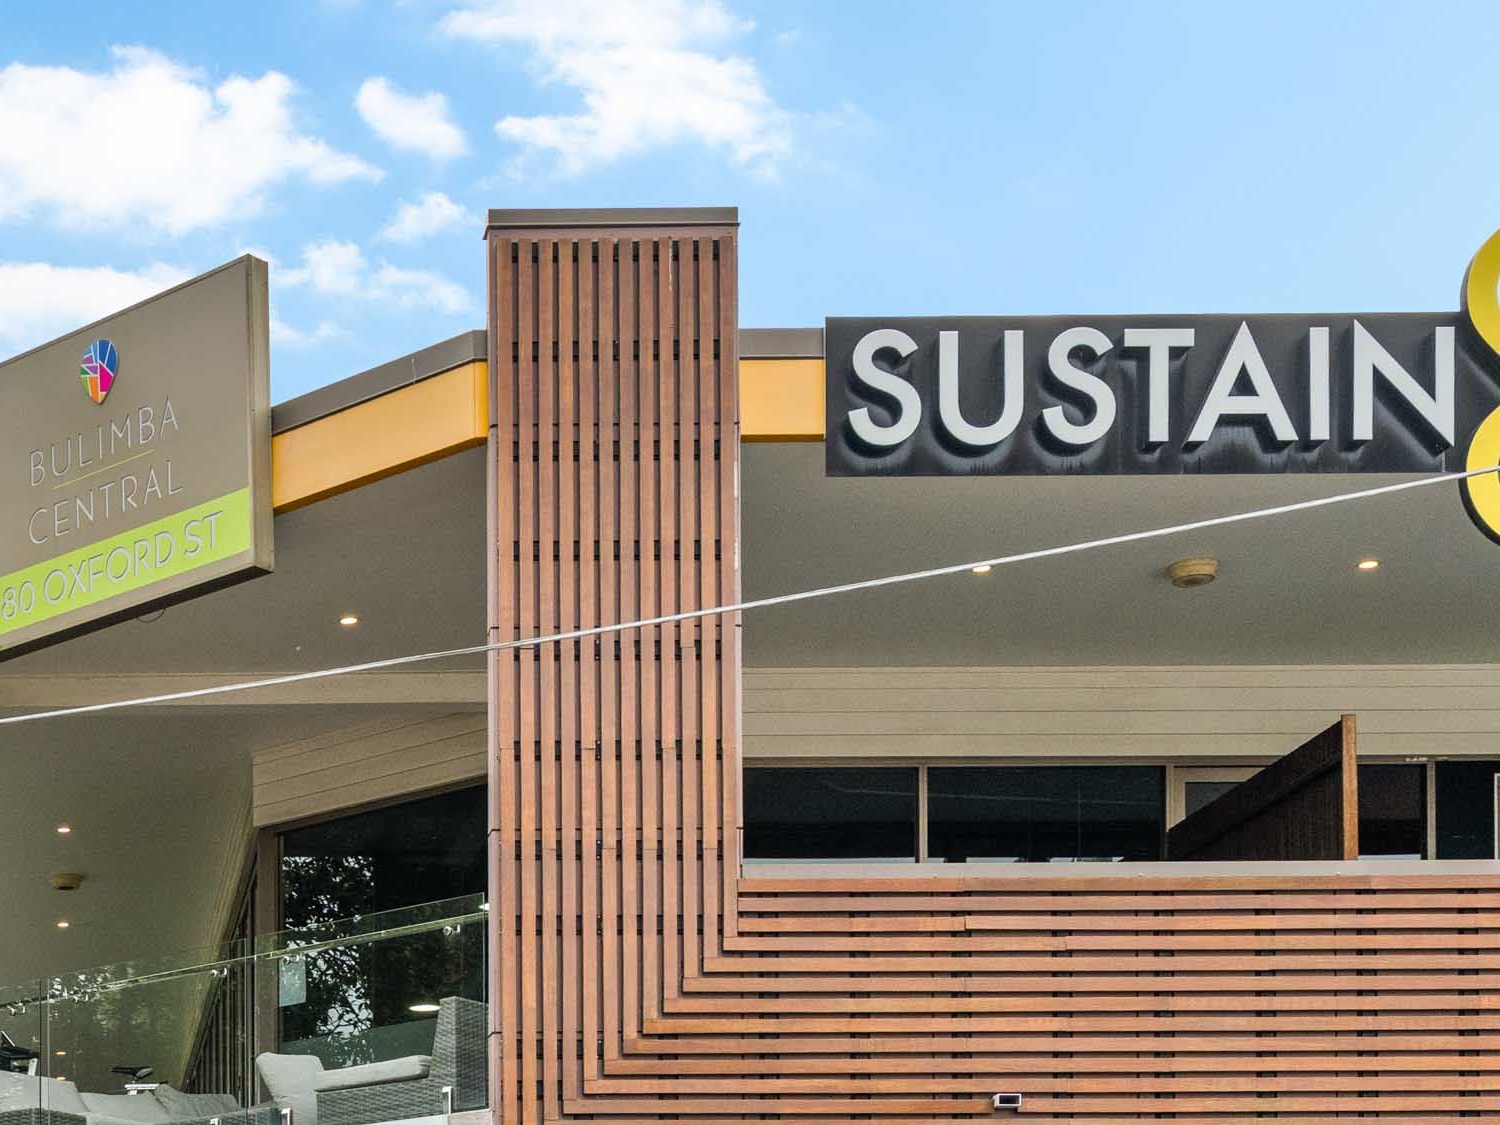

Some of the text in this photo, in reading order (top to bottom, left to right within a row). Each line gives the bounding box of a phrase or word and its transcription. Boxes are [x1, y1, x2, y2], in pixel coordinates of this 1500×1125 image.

[848, 318, 1456, 448] SUSTAIN
[29, 396, 180, 488] BULIMBA
[28, 460, 184, 546] CENTRAL
[43, 530, 176, 606] OXFORD
[184, 511, 222, 557] ST
